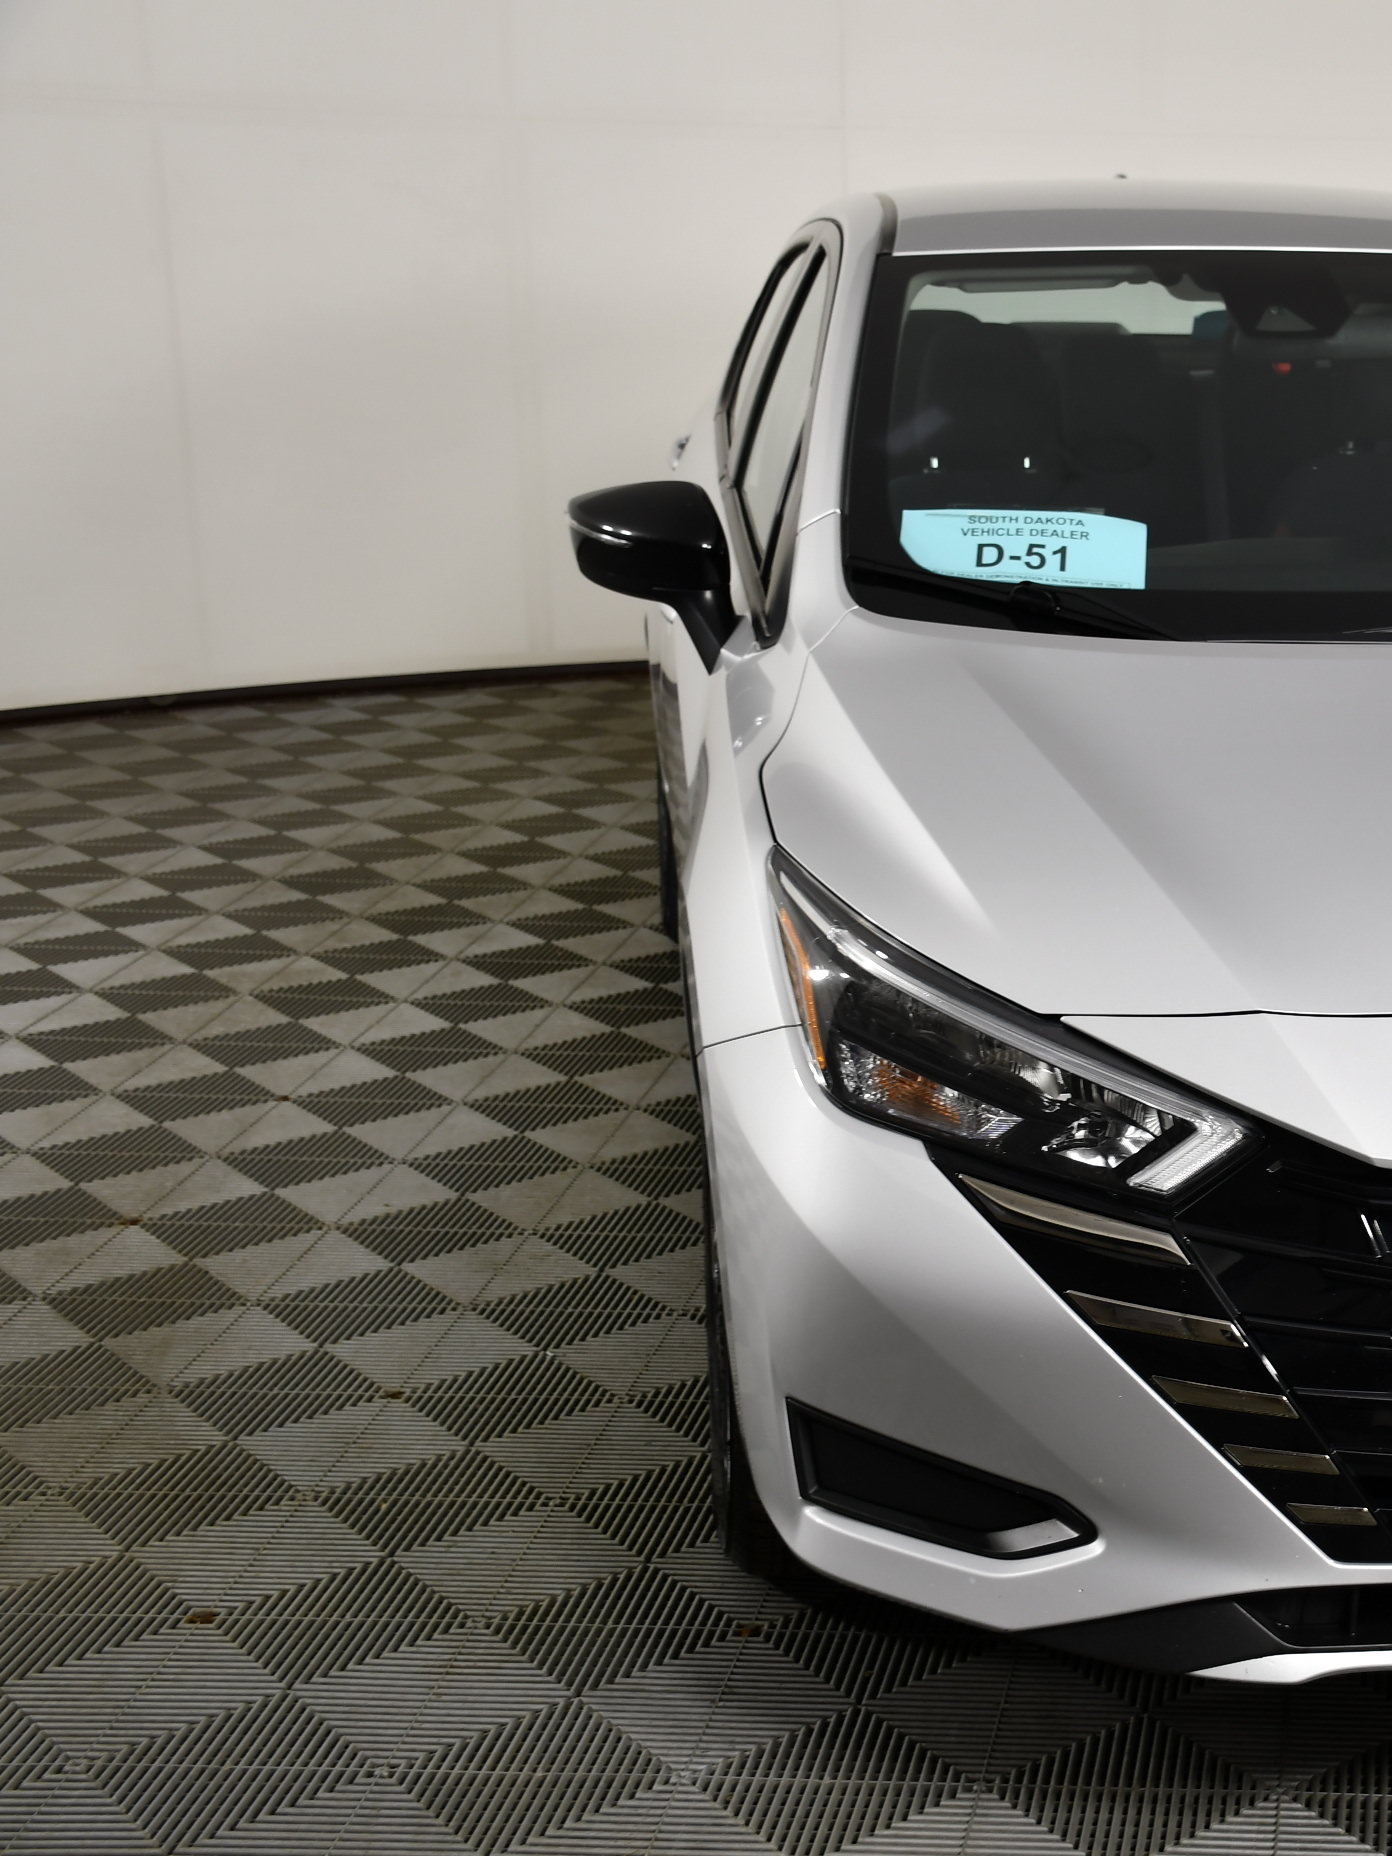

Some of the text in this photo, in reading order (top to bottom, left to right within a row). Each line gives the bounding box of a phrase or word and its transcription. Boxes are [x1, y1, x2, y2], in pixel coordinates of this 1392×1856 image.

[967, 515, 1085, 527] SOUTH DAKOTA
[960, 527, 1090, 541] VEHICLE DEALER
[975, 543, 1068, 572] D-51
